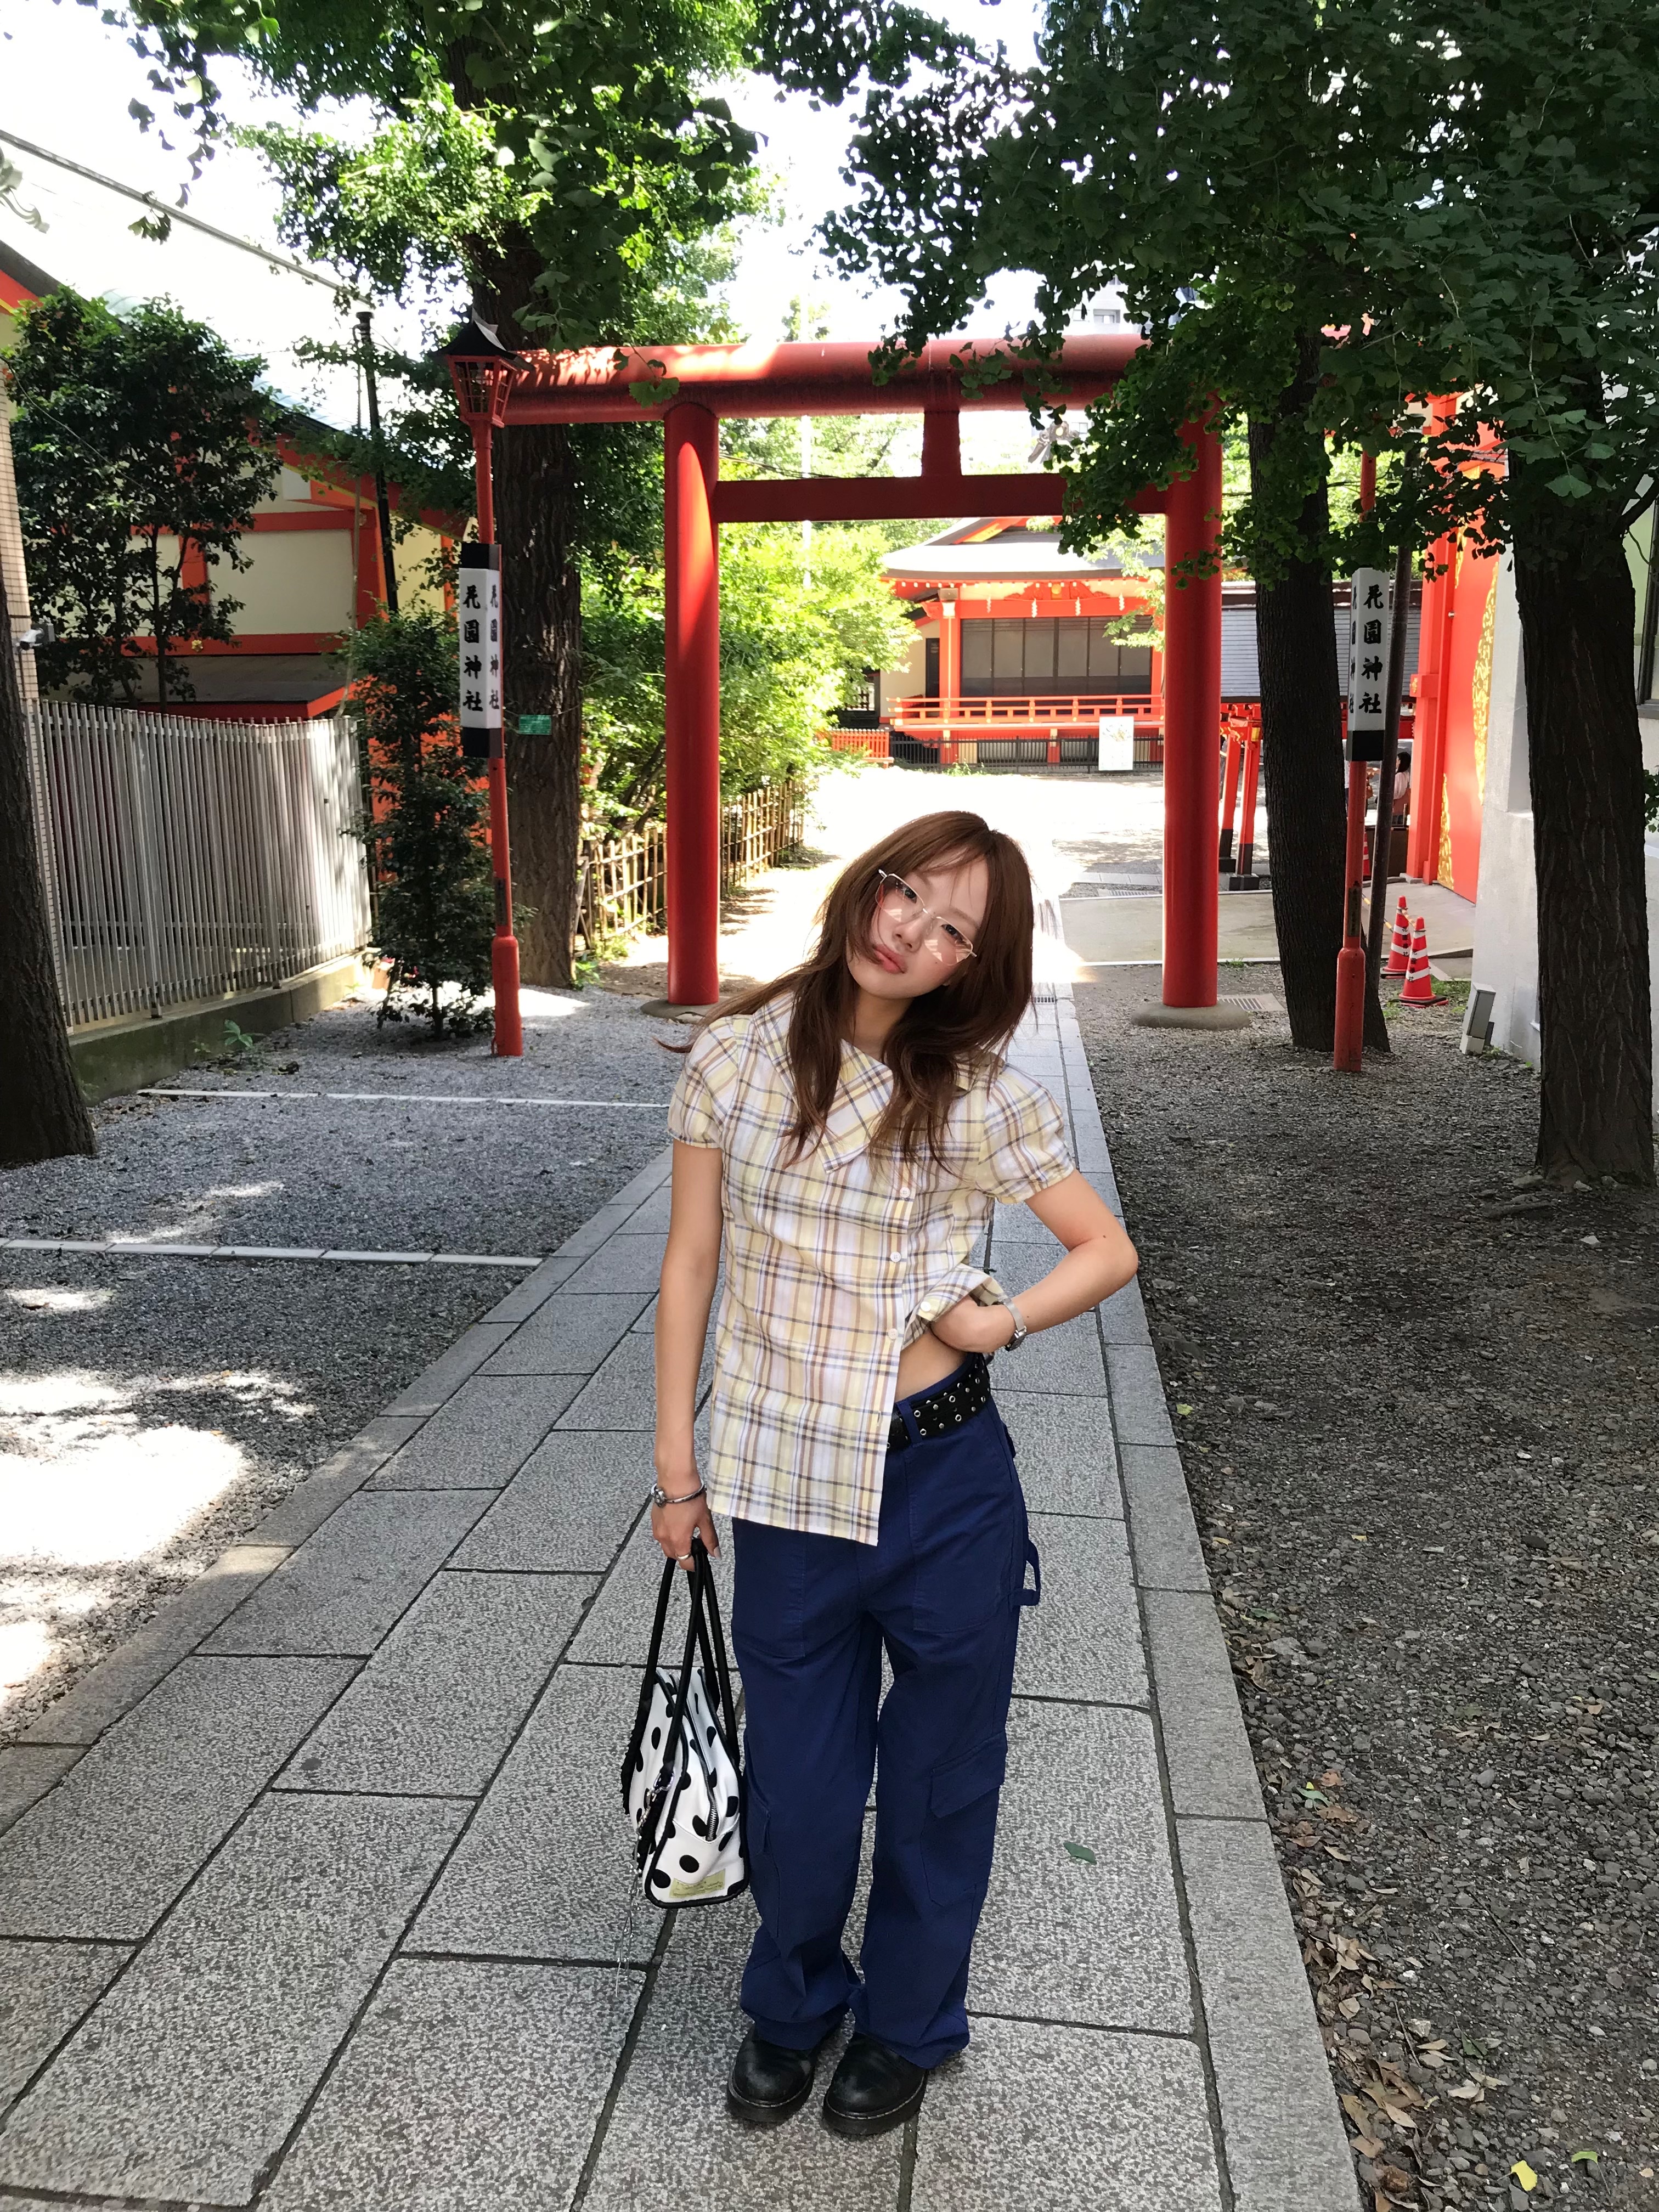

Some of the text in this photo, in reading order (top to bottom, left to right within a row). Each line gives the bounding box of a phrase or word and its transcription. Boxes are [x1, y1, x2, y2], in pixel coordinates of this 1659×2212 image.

[462, 585, 483, 712] 花園神社
[1359, 584, 1384, 714] 花園神社
